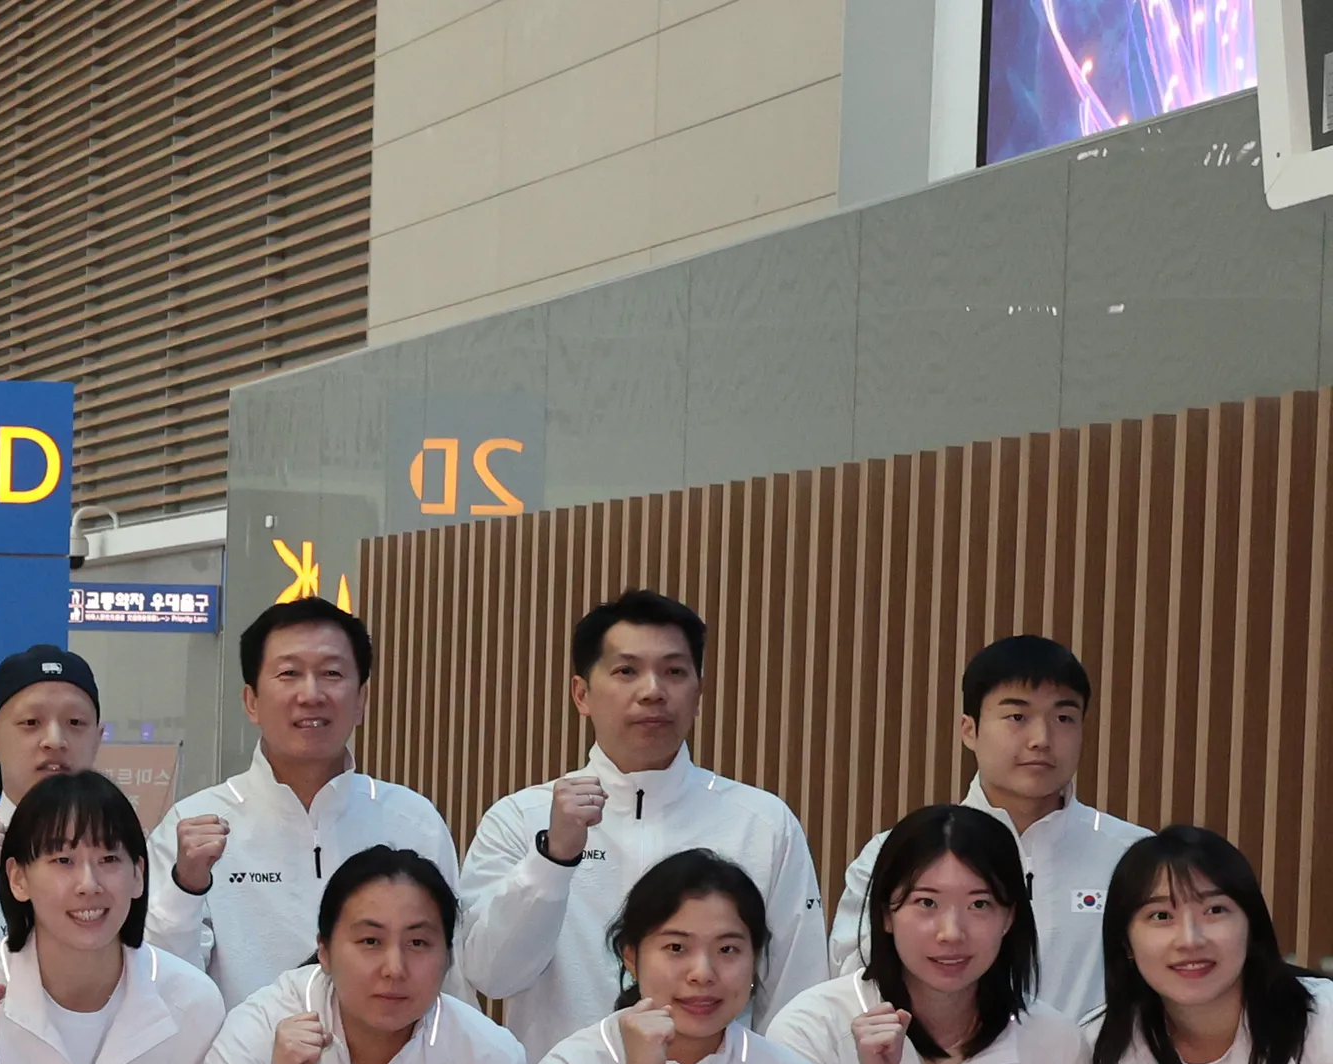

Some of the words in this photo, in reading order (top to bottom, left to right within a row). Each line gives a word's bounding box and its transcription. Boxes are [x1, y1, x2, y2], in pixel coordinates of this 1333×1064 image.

[85, 592, 145, 611] 교통약자
[150, 592, 209, 612] 우대출구
[581, 849, 606, 860] ONEX
[249, 872, 282, 883] YONEX
